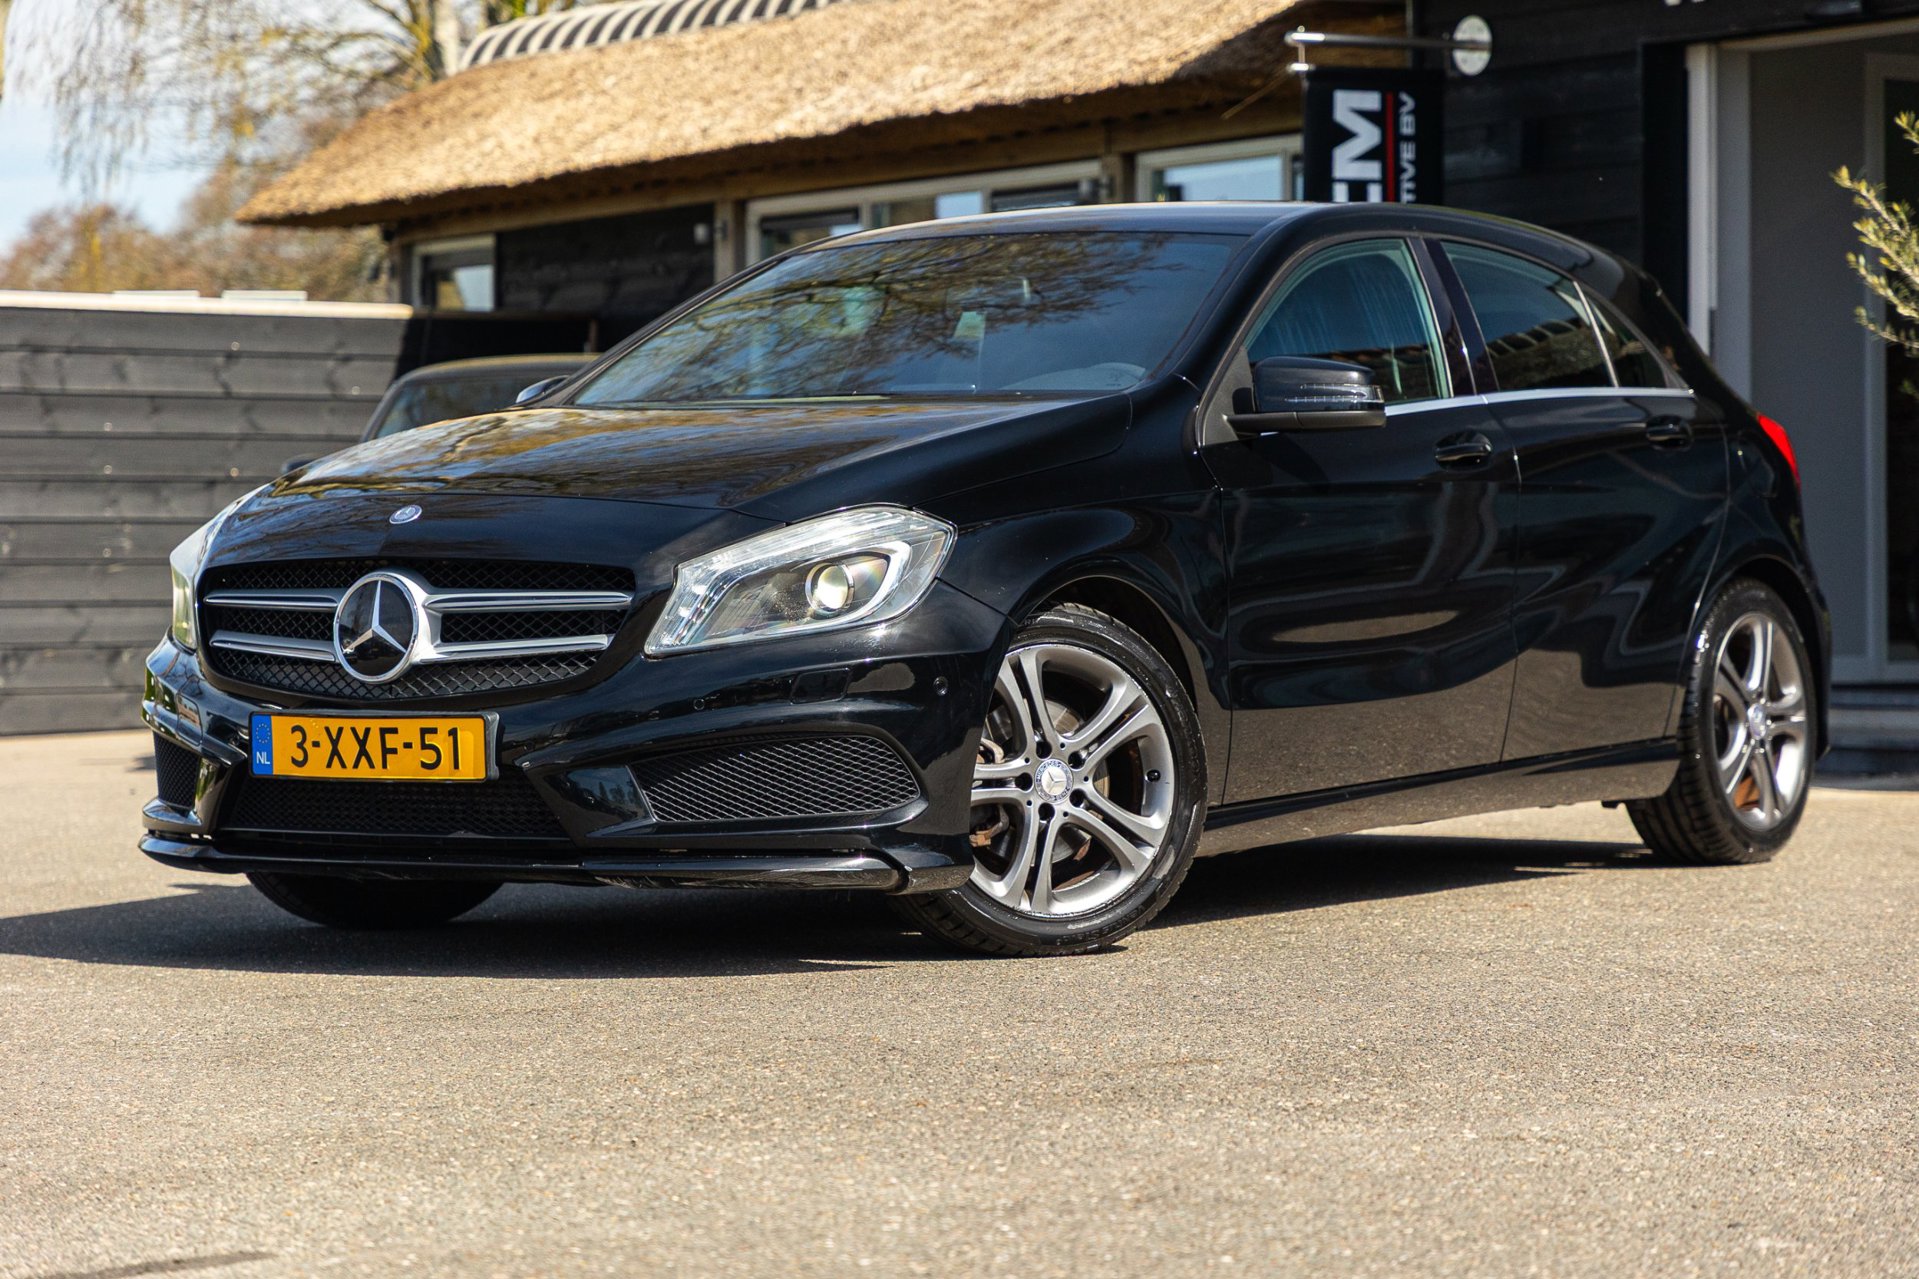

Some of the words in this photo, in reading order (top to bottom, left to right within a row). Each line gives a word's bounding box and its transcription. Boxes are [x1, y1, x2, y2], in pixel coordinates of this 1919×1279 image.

[1400, 92, 1416, 136] BV
[256, 752, 271, 765] NL
[290, 724, 461, 771] 3-XXF-51
